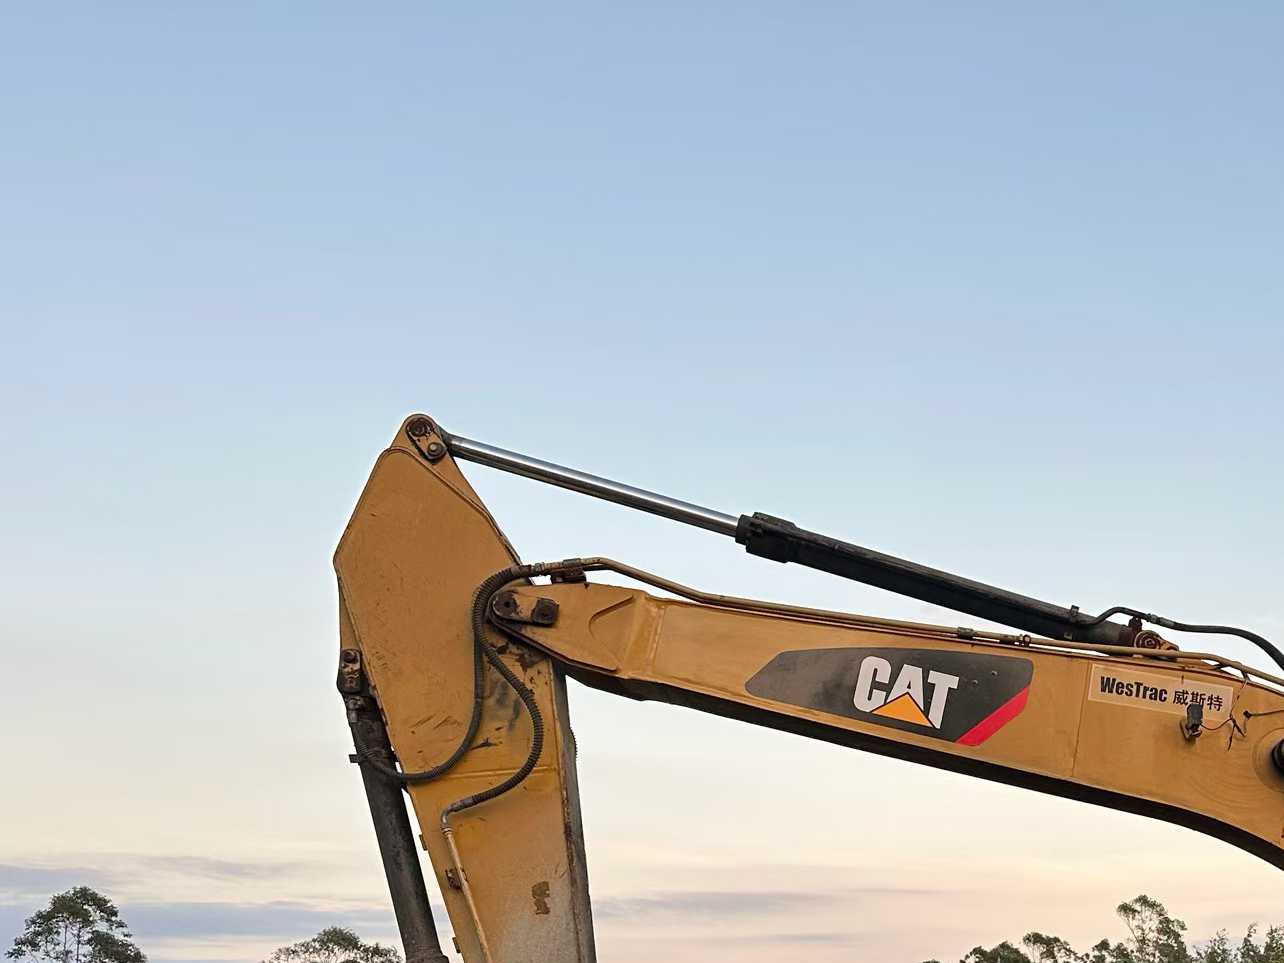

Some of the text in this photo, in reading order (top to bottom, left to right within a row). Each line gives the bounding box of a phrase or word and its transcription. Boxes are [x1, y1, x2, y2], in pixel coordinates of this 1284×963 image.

[853, 655, 960, 730] CAT
[1100, 676, 1223, 712] WesTrac 威斯特
